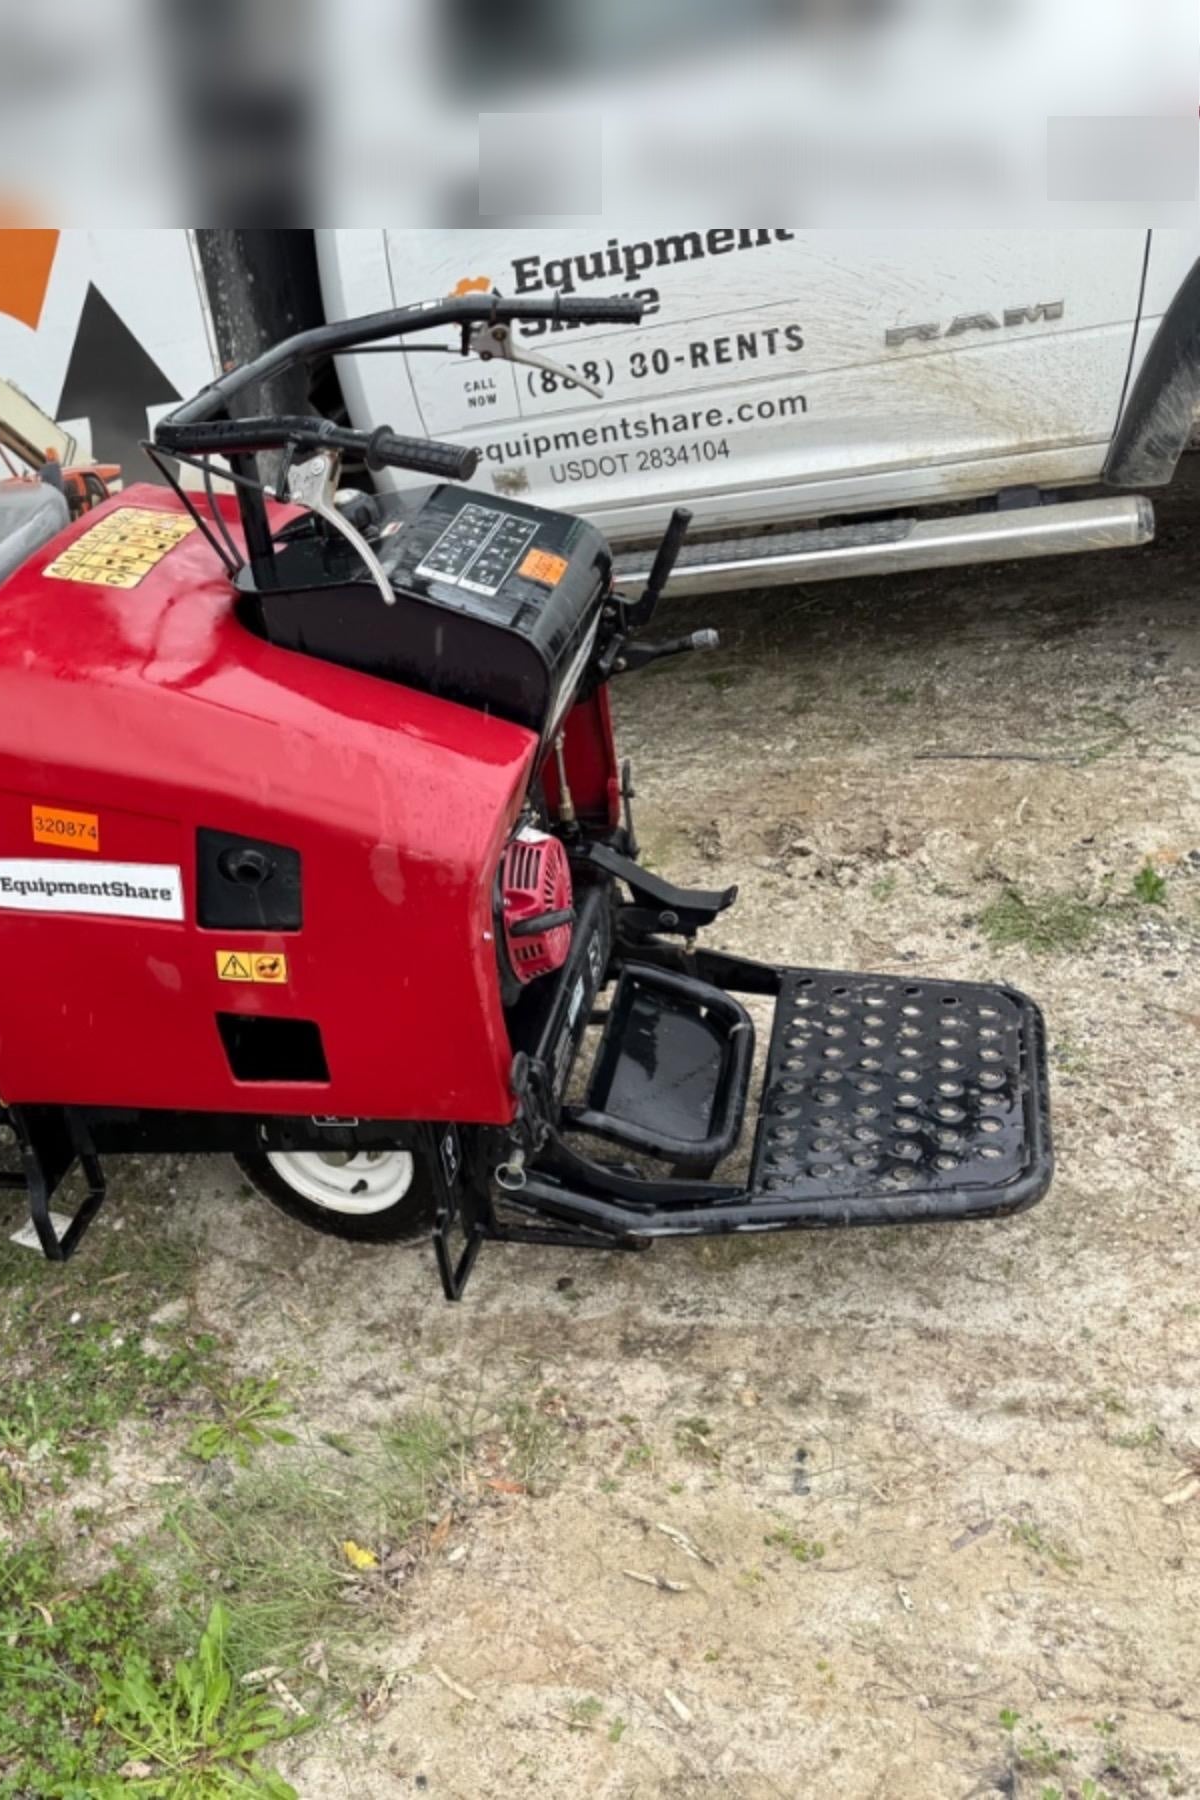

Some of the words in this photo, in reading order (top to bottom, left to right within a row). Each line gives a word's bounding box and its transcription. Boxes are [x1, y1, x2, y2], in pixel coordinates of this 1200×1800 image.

[885, 299, 1064, 346] RAM
[464, 377, 496, 392] CALL
[467, 393, 496, 408] NOW
[550, 453, 630, 484] USDOT
[638, 438, 730, 471] 2834104
[34, 815, 97, 840] 320874
[0, 876, 172, 901] EquipmentShare
